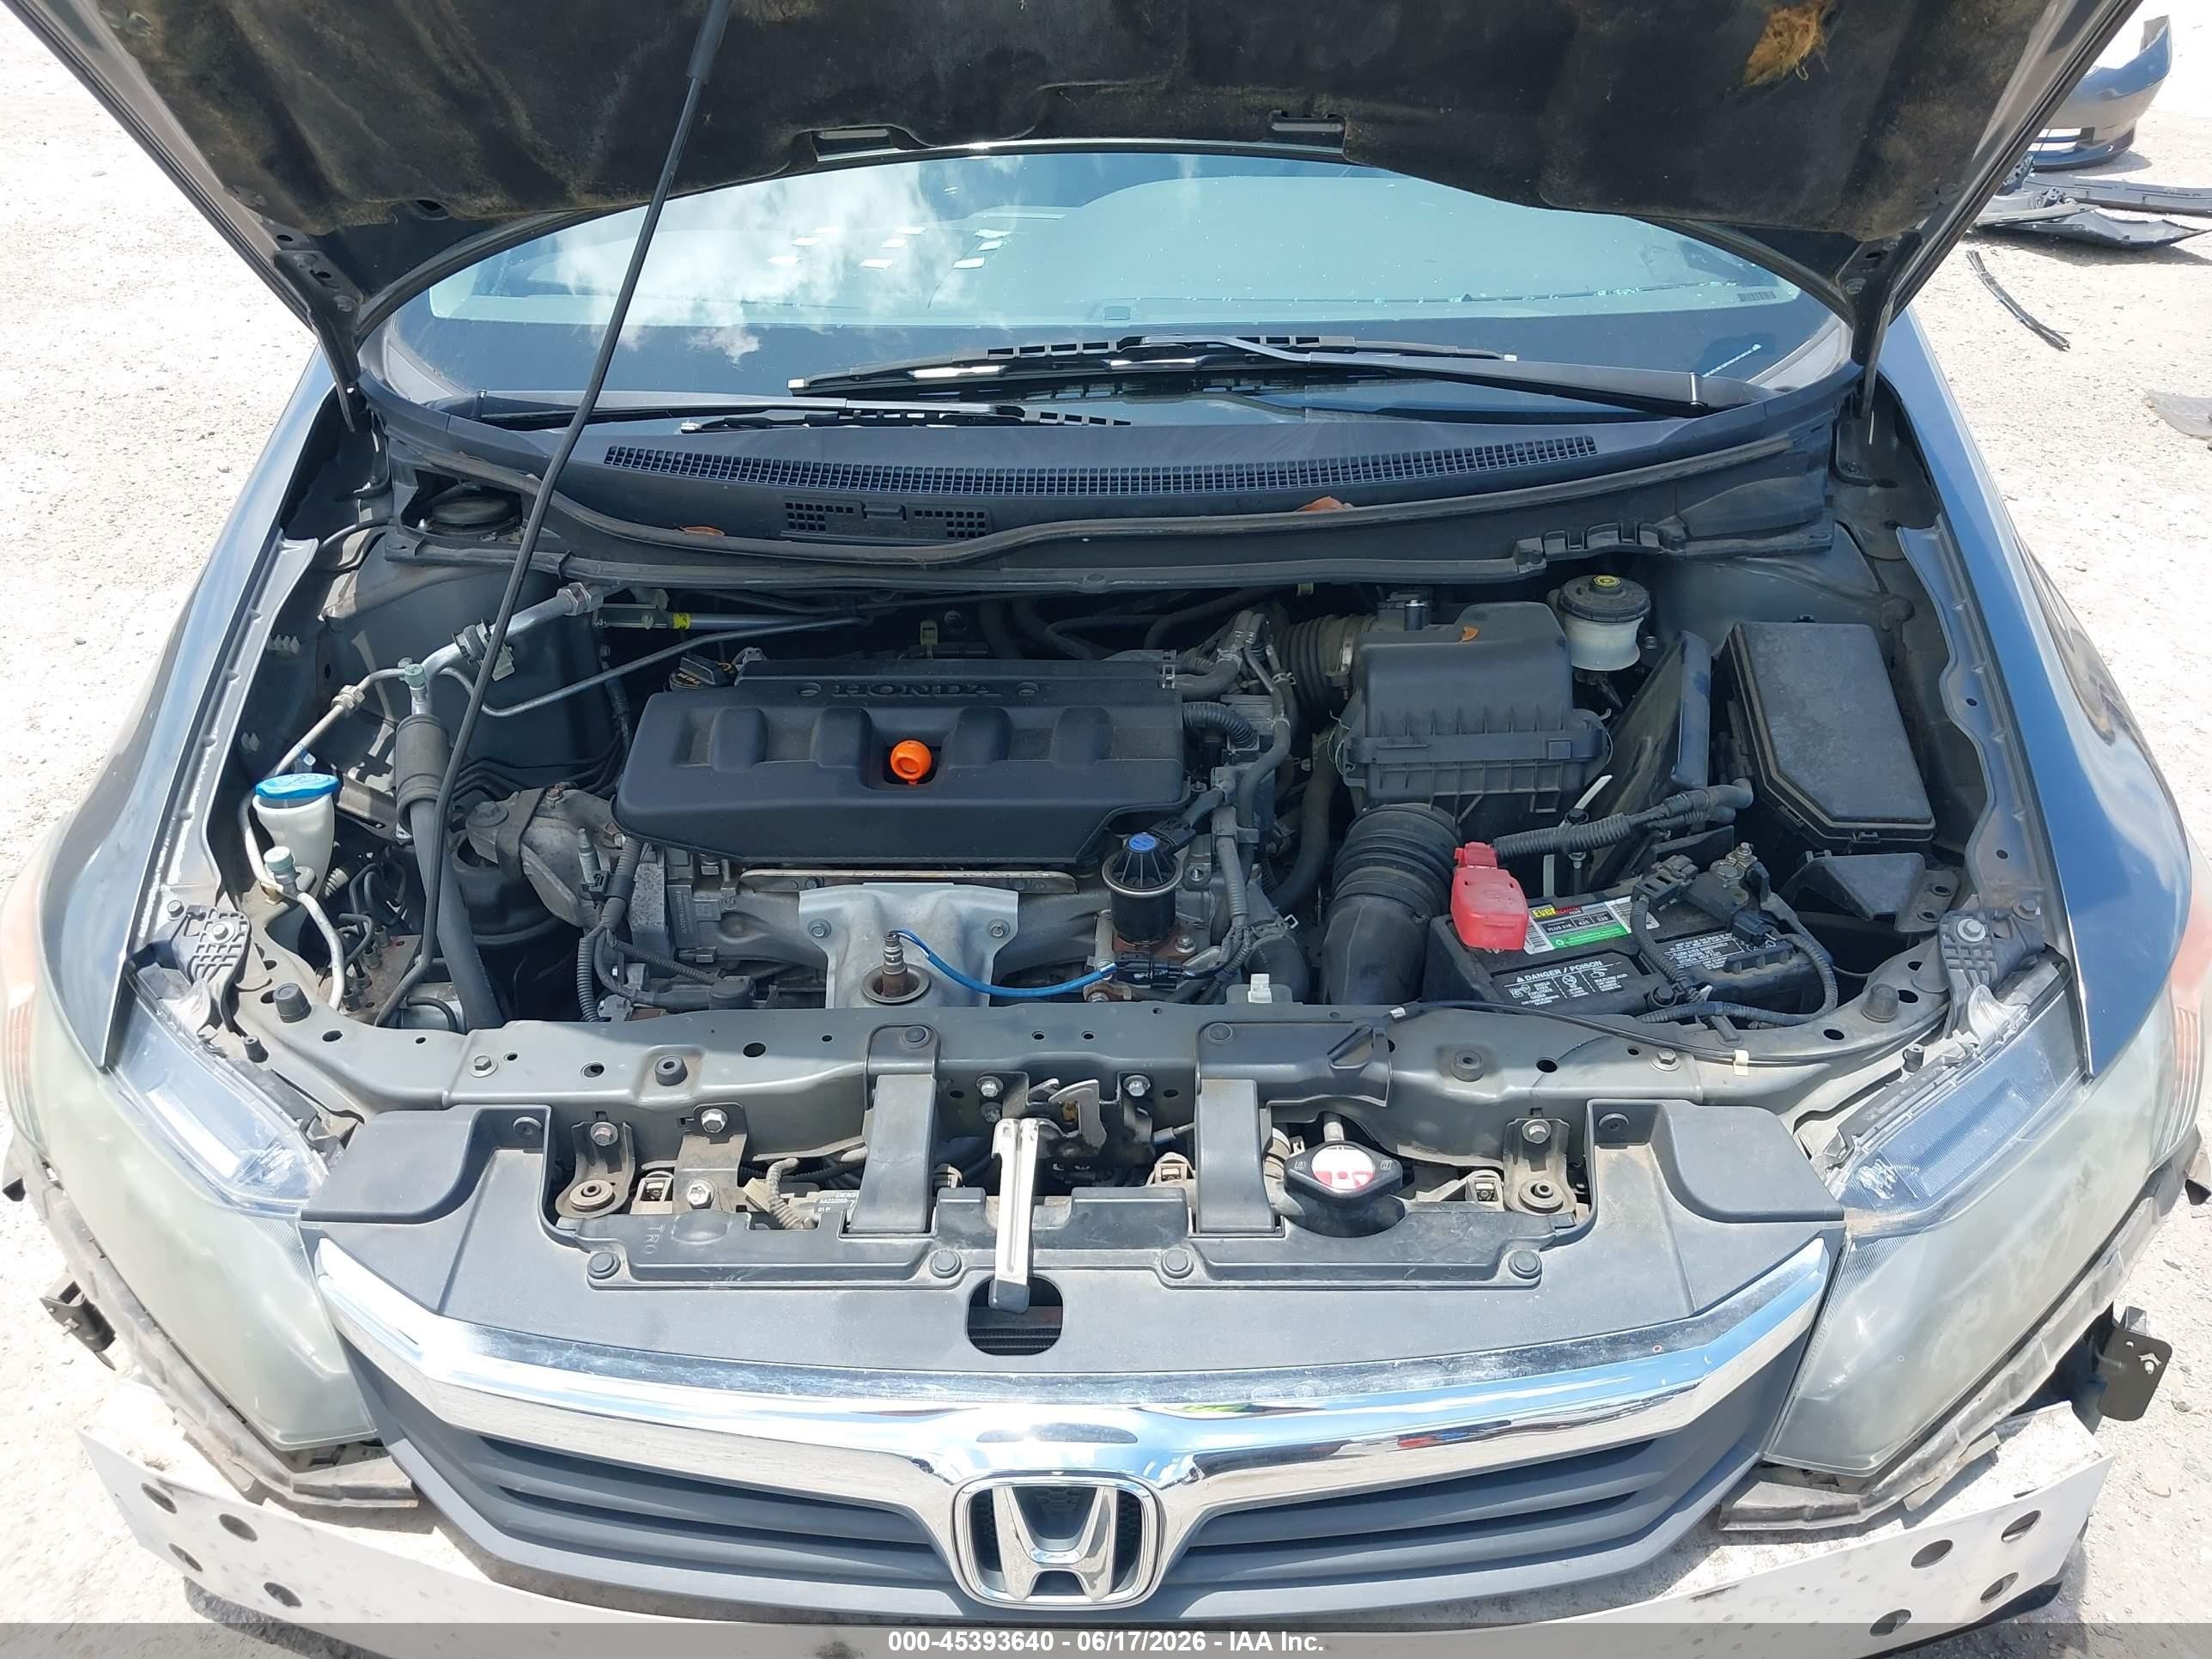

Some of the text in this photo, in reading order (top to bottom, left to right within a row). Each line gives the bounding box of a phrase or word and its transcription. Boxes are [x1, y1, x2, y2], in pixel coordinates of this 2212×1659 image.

[831, 684, 1003, 697] HONDA
[1524, 969, 1562, 981] DANGER
[1569, 960, 1603, 971] POISON
